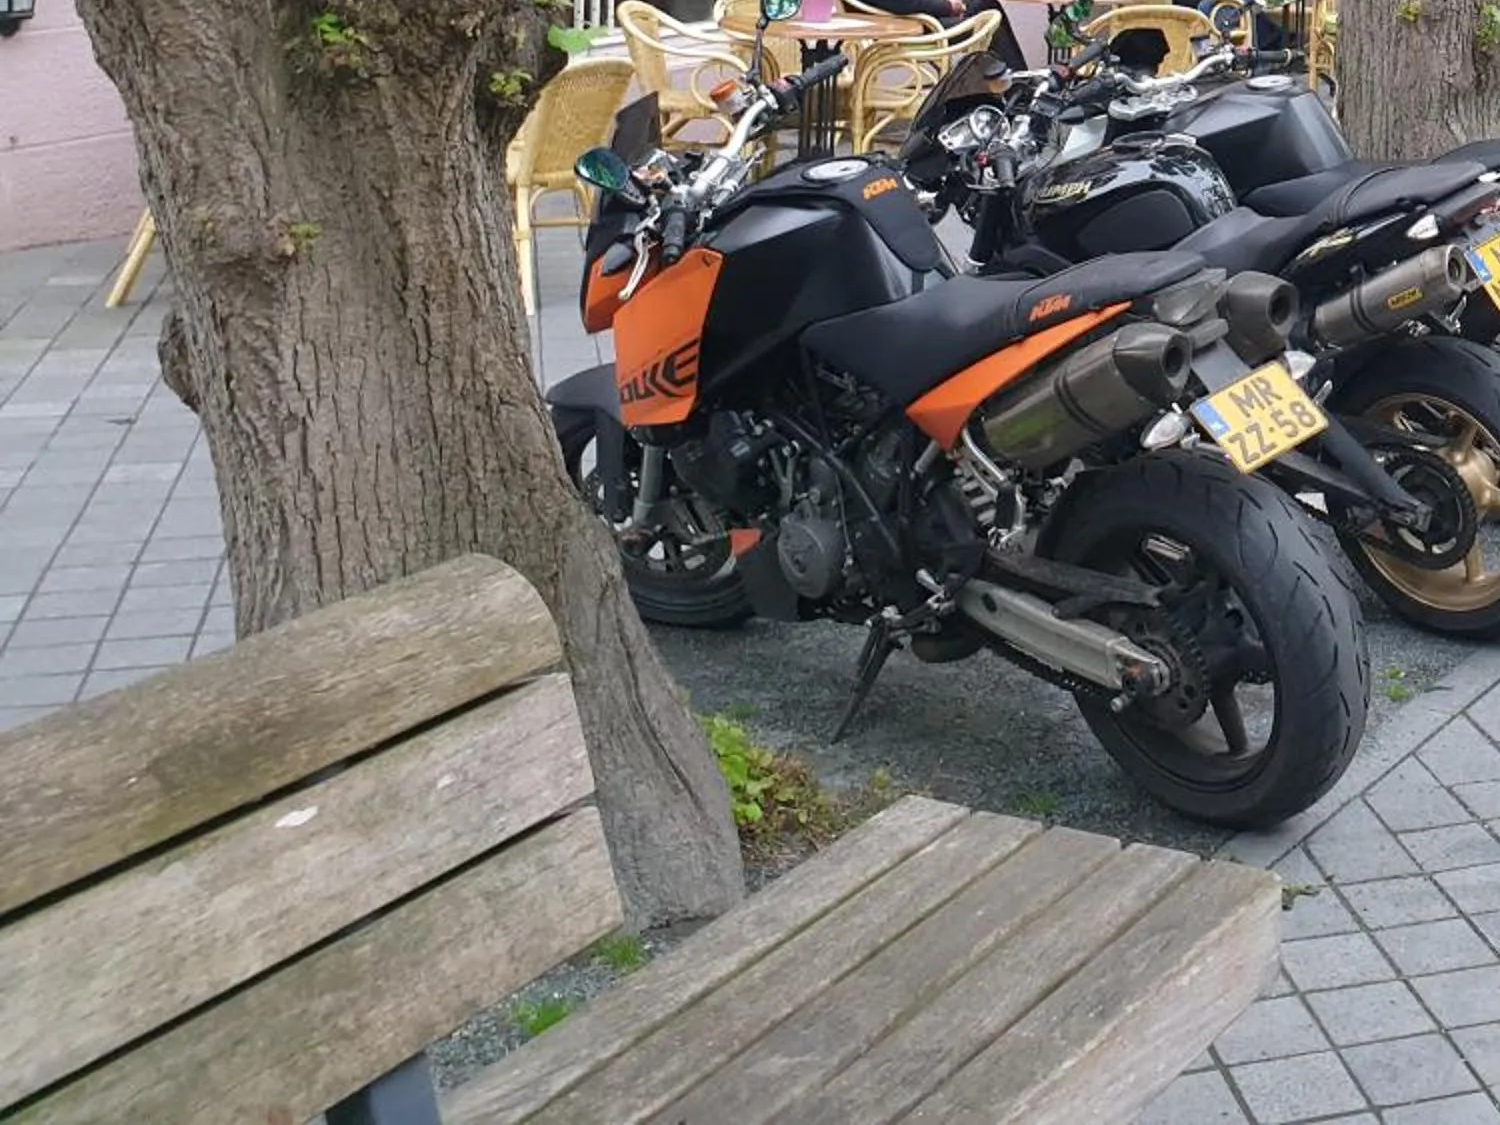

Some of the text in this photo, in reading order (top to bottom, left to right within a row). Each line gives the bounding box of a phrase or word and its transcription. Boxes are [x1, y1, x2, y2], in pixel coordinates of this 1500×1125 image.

[863, 178, 898, 200] KTM
[1028, 293, 1072, 322] KTM
[1228, 375, 1284, 418] MR
